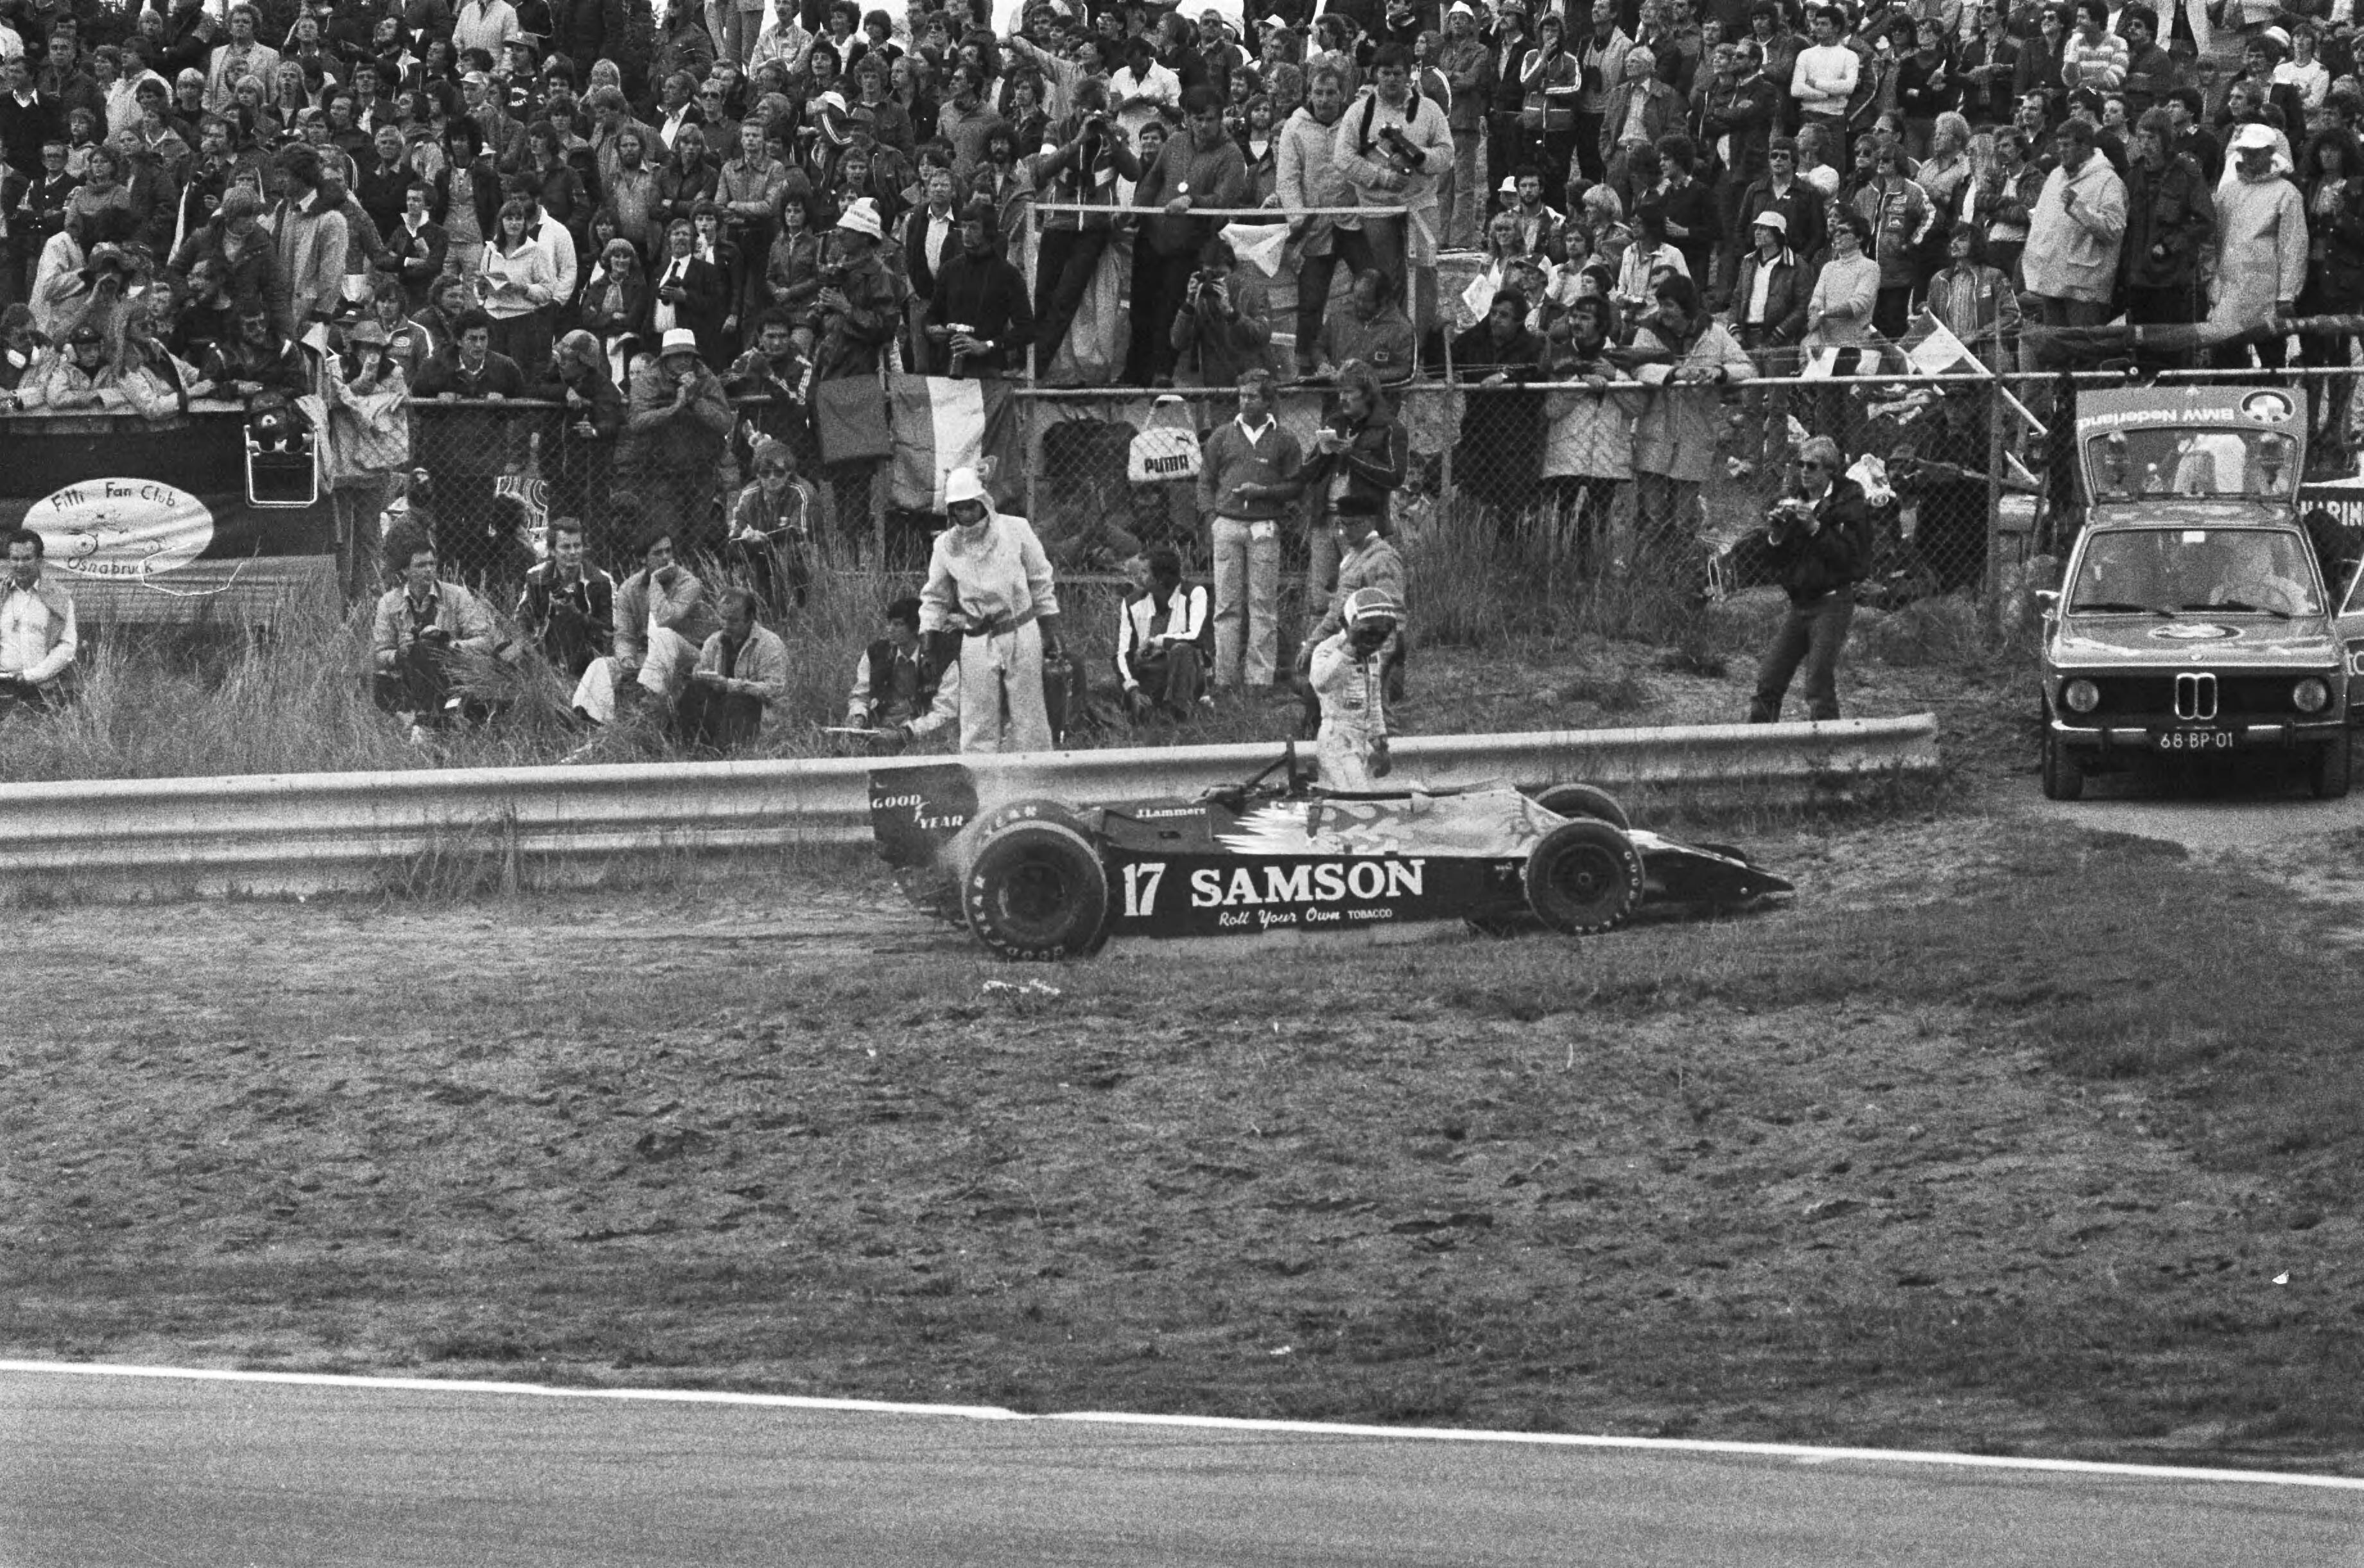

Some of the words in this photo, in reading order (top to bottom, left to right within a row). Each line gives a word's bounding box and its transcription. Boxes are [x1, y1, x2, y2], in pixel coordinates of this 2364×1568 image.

[2183, 408, 2235, 421] BMW
[1145, 455, 1189, 474] PUMA
[105, 482, 132, 498] Fan
[141, 485, 175, 507] Club
[872, 794, 921, 808] GOOD
[920, 815, 963, 829] YEAR
[1122, 862, 1166, 917] 17
[1190, 858, 1425, 907] SAMSON
[1219, 911, 1249, 927] Roll
[1258, 909, 1297, 929] Your
[1306, 907, 1340, 921] Own
[1348, 909, 1393, 920] TOBACCO
